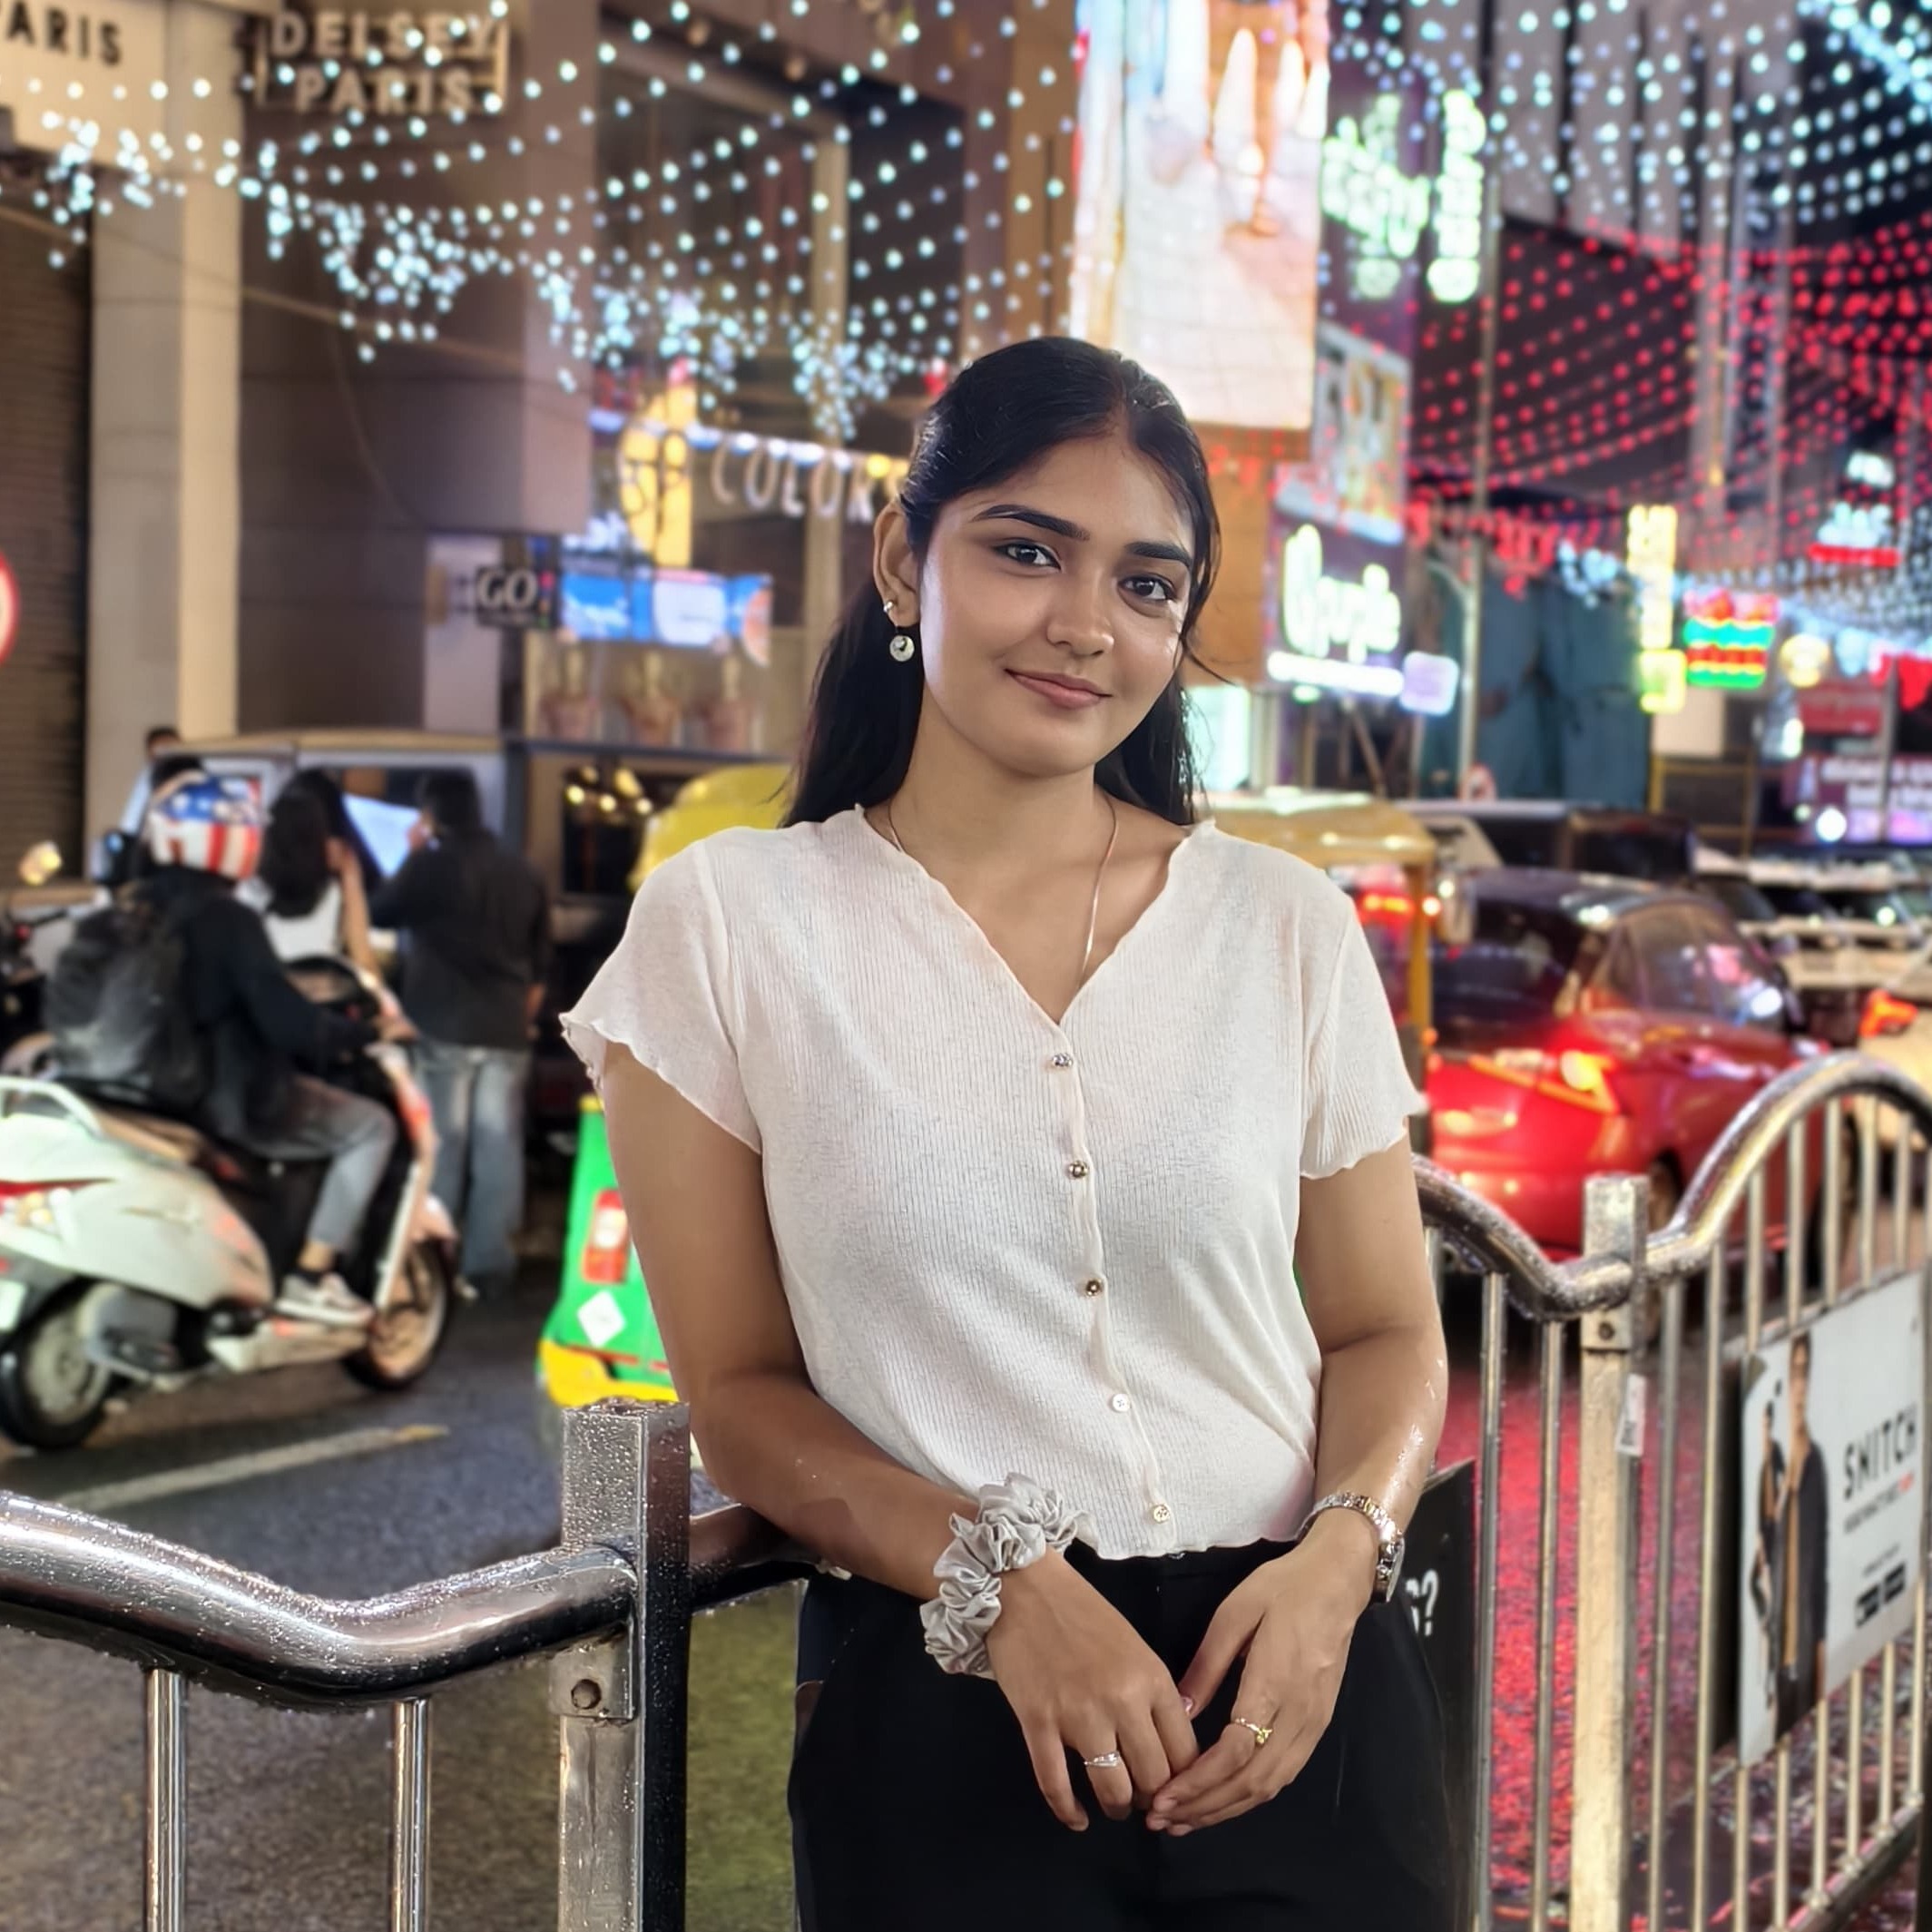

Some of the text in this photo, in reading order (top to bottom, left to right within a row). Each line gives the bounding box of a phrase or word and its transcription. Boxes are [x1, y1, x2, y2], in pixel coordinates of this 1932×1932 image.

[0, 0, 122, 67] ARIS
[271, 11, 496, 60] DELSEY
[295, 67, 474, 115] PARIS
[476, 569, 537, 609] GO
[1843, 1403, 1917, 1500] SNITCH
